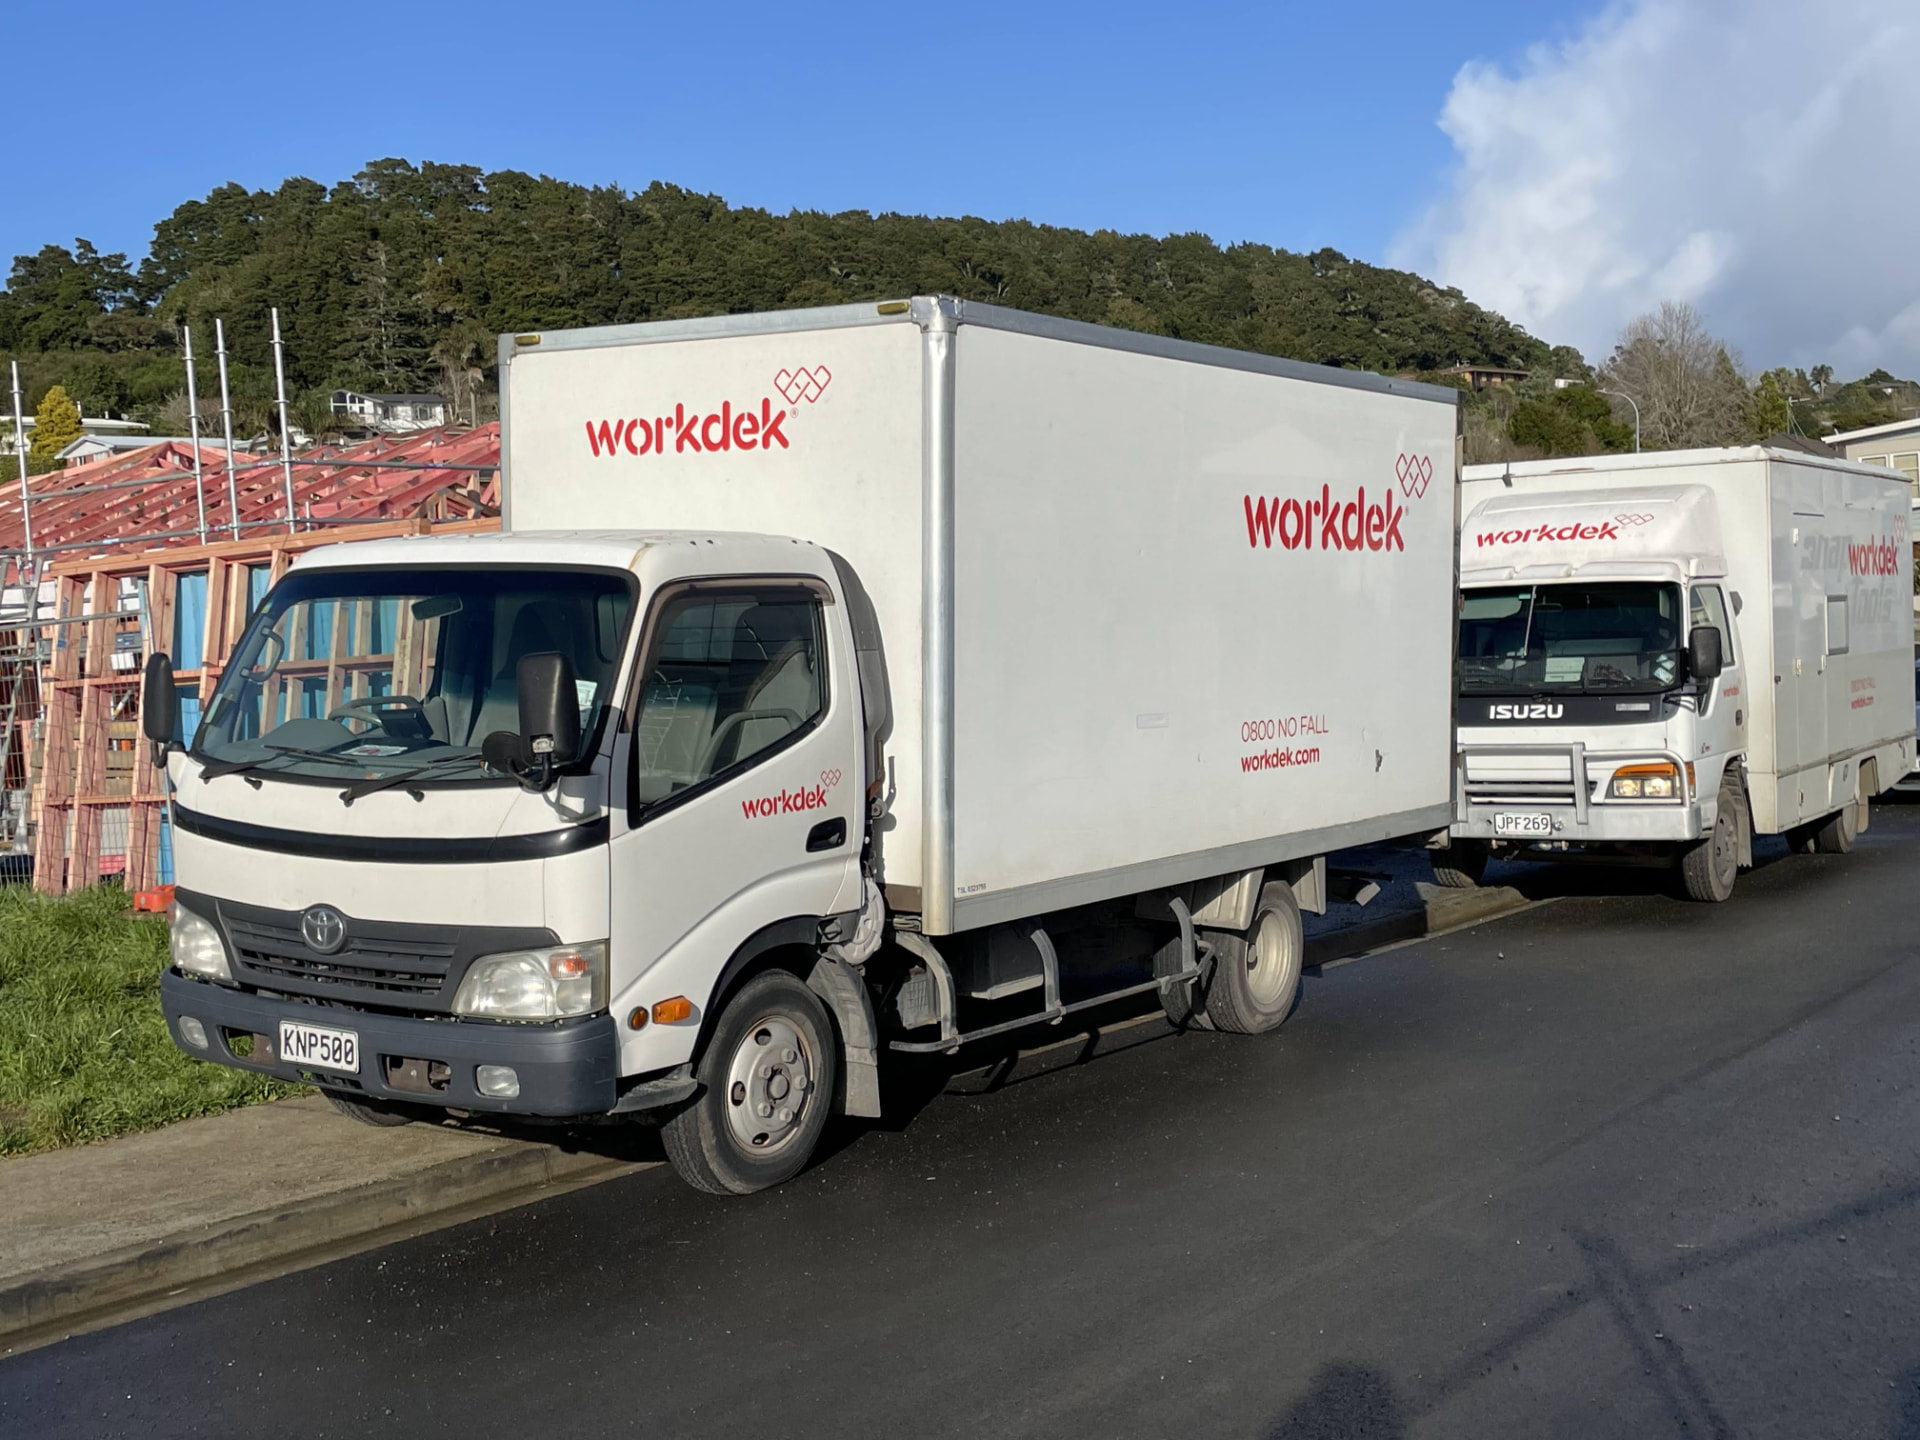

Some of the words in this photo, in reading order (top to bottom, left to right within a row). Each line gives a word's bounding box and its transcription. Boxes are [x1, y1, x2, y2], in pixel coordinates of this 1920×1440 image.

[586, 397, 789, 457] workdek
[1244, 483, 1404, 552] workdek
[1477, 522, 1619, 548] workdek
[1847, 534, 1898, 576] workdek
[1489, 703, 1564, 720] ISUZU
[1241, 721, 1275, 742] 0800
[1278, 717, 1298, 738] NO
[1300, 714, 1329, 736] FALL
[1241, 746, 1320, 773] workdek.com
[742, 784, 827, 819] workdek
[1497, 816, 1549, 830] JPF269
[284, 1028, 355, 1066] KNP500
